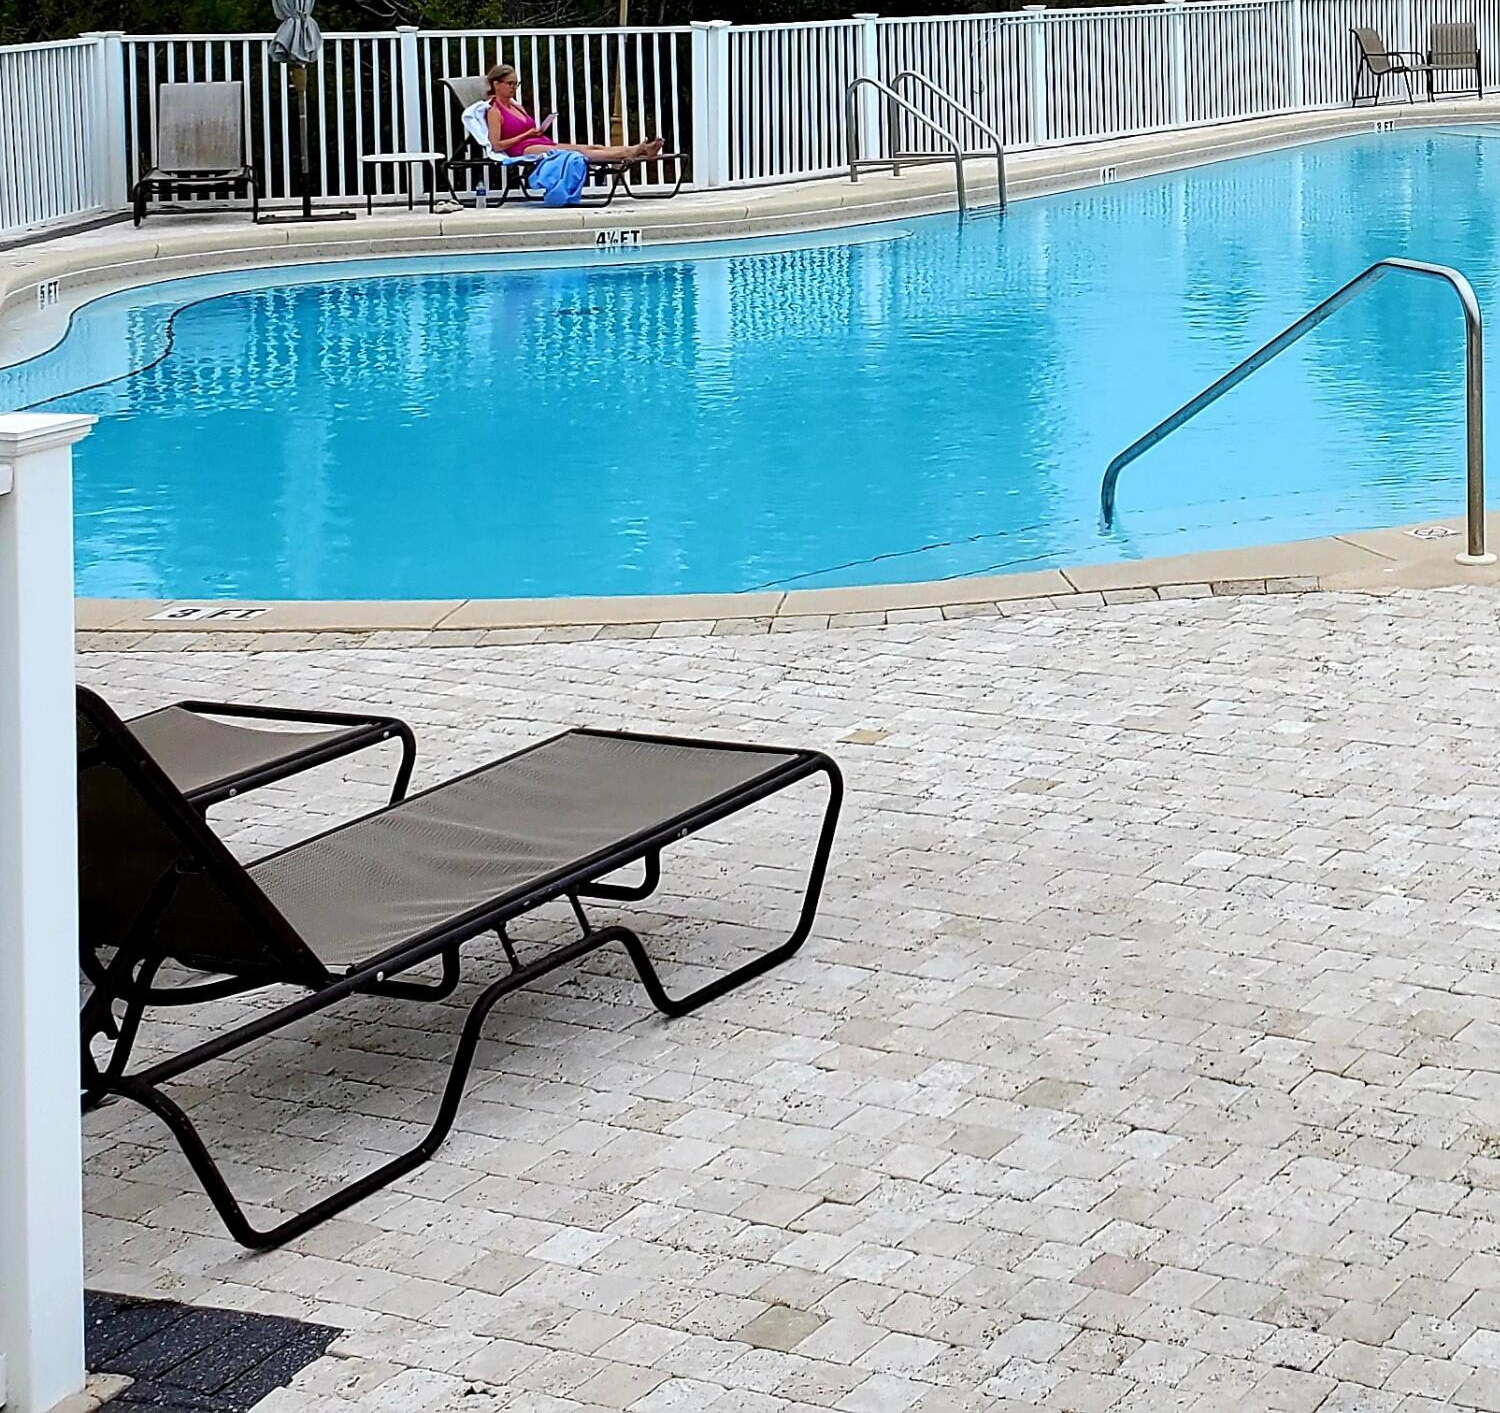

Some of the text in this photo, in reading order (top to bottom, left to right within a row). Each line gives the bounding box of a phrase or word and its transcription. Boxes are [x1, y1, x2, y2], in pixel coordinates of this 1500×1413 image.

[1384, 120, 1394, 132] FT
[1108, 167, 1116, 181] FT
[620, 230, 640, 244] FT
[47, 280, 59, 301] FT
[167, 608, 268, 619] 3 FT
